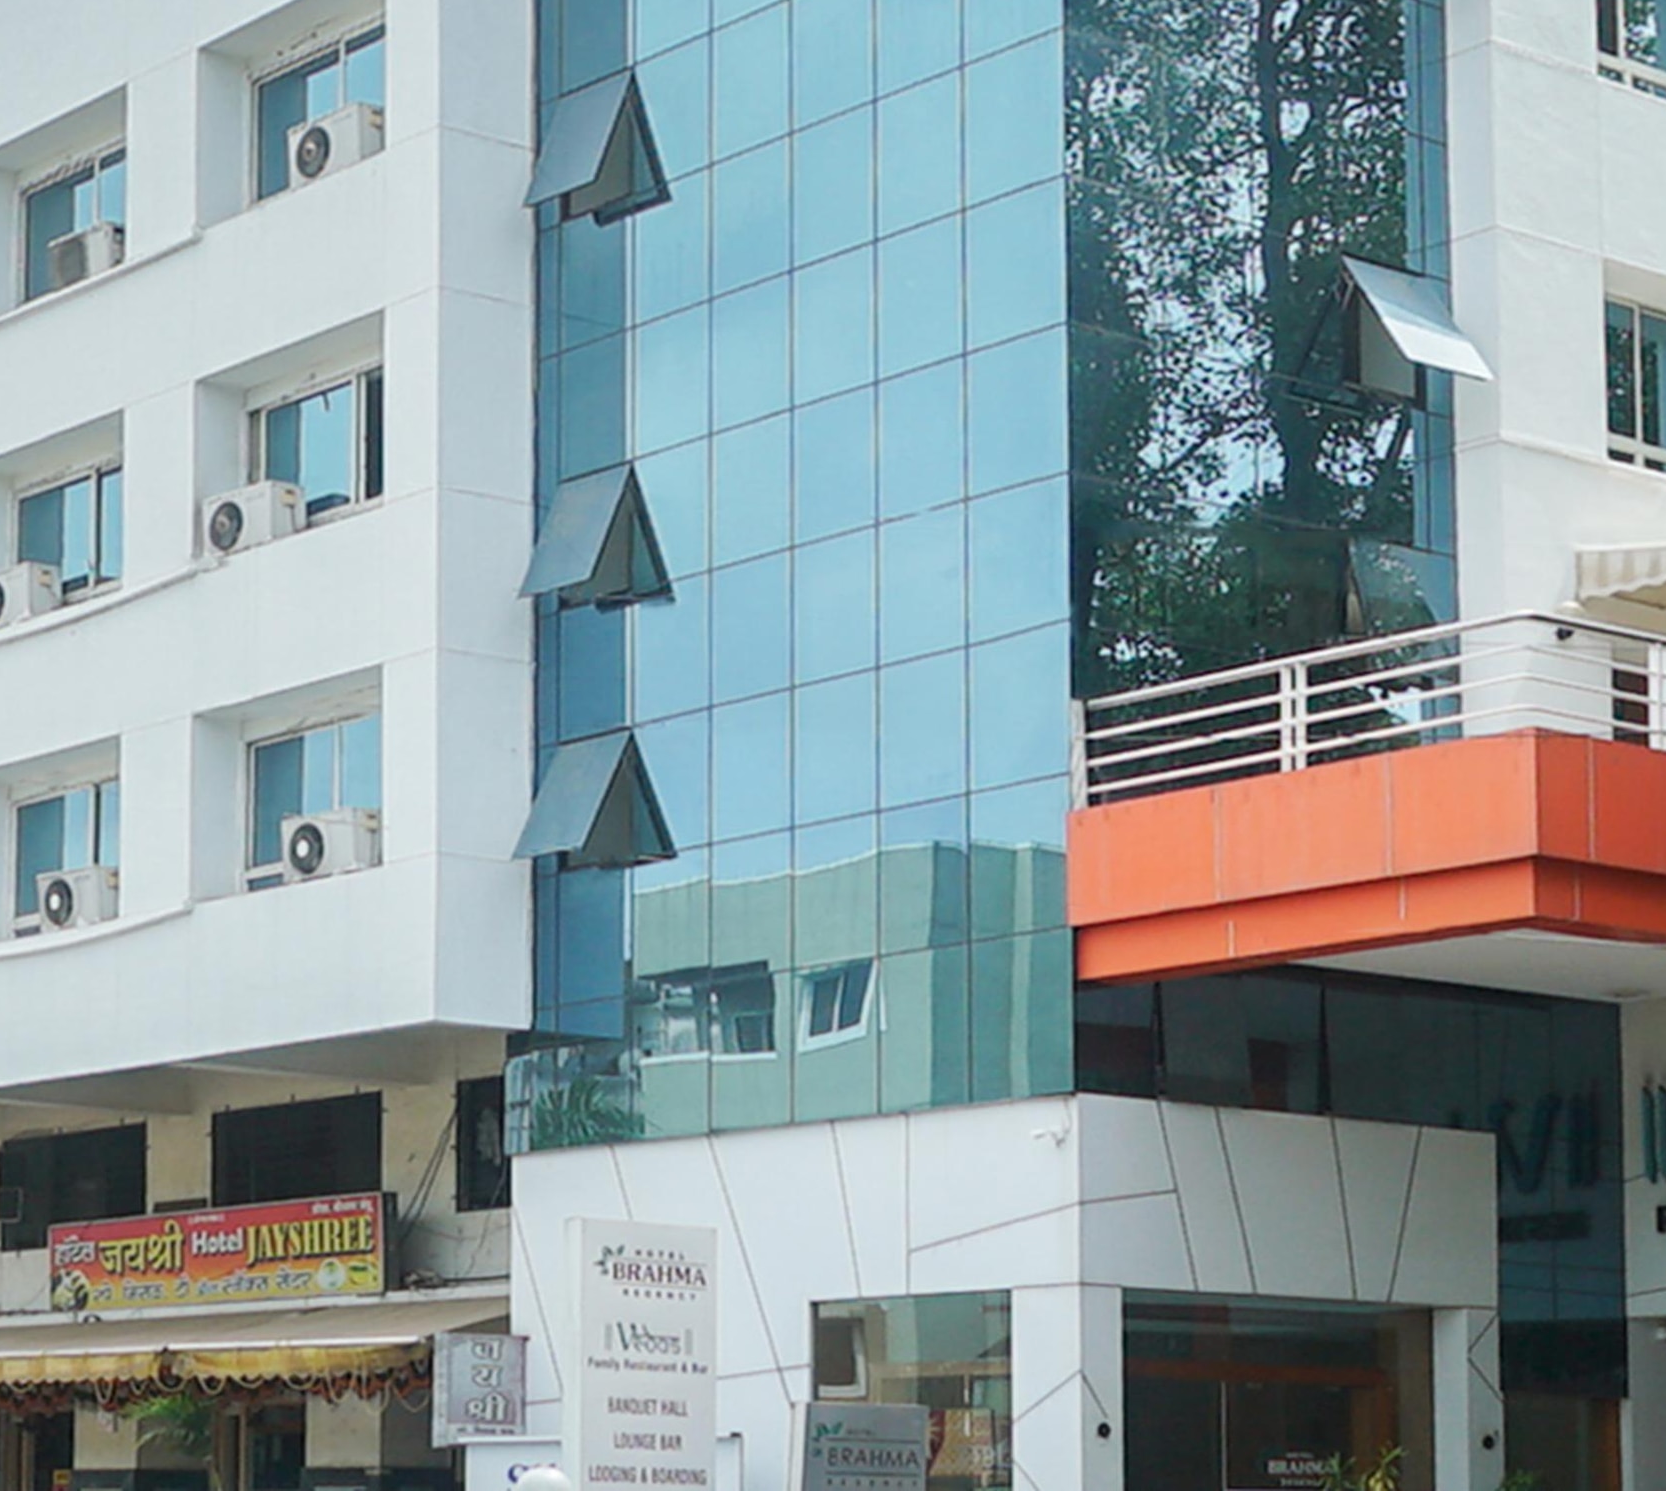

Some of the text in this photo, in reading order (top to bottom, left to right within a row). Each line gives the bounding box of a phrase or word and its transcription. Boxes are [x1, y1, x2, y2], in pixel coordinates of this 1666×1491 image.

[98, 1219, 184, 1274] जयश्री
[191, 1215, 376, 1267] Hotel JAYSHREE
[613, 1261, 707, 1286] BRAHMA
[588, 1356, 620, 1372] Family
[623, 1358, 678, 1373] Restaurant
[691, 1361, 709, 1375] Bar
[608, 1396, 689, 1418] BANQUET HALL
[613, 1431, 683, 1451] LOUNGE BAR
[826, 1445, 922, 1469] BRAHMA
[589, 1464, 638, 1484] LODGING
[651, 1467, 709, 1486] BOARDING
